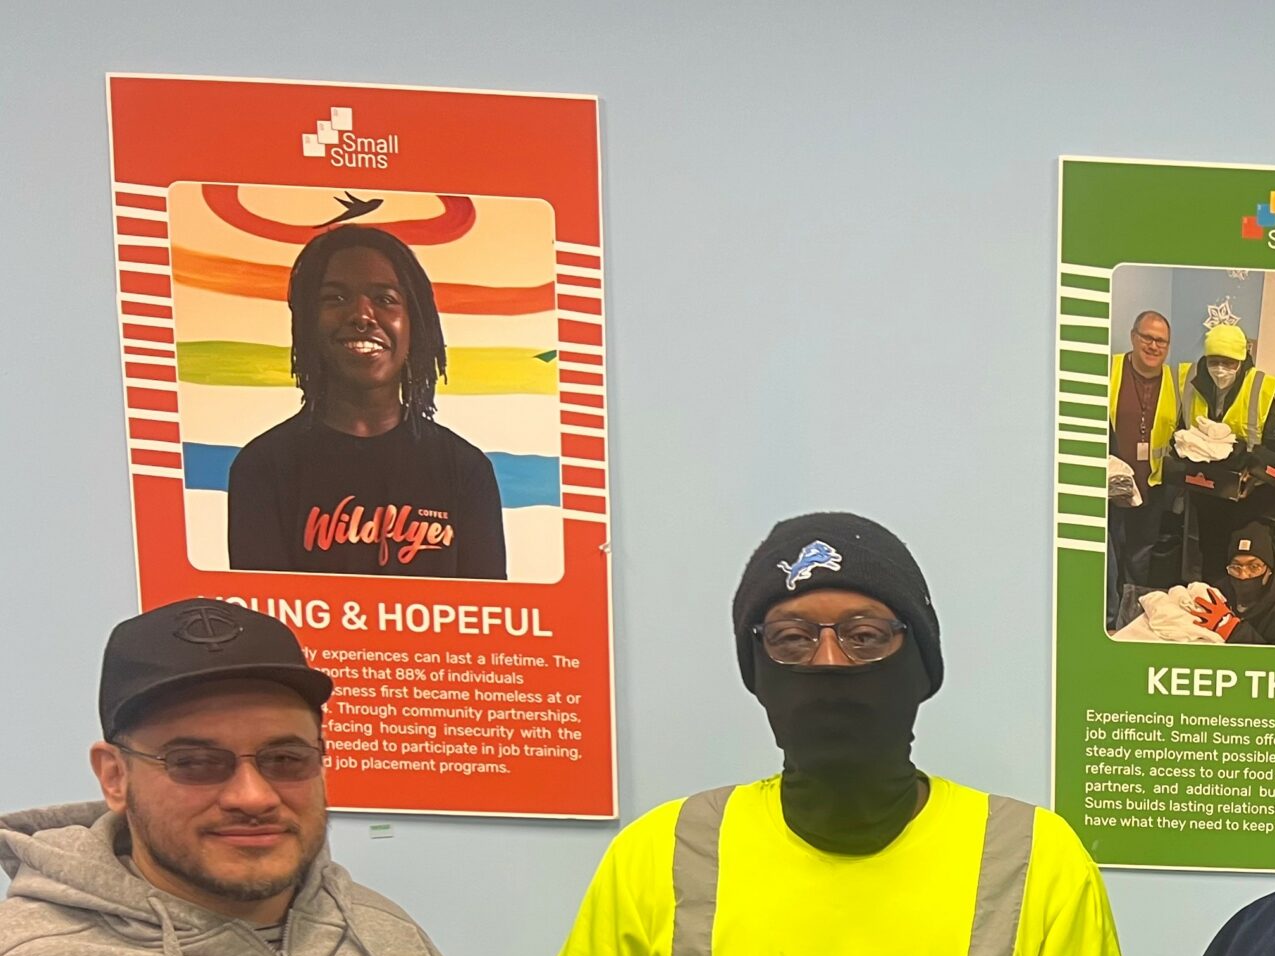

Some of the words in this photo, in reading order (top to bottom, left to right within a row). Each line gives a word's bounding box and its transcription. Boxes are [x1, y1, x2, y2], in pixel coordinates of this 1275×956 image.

[342, 132, 399, 155] Small
[330, 148, 388, 169] Sums
[418, 508, 448, 519] COFFEE
[303, 495, 454, 566] Wildflyer
[341, 601, 368, 631] &
[378, 602, 553, 637] HOPEFUL
[322, 649, 409, 663] experiences
[414, 652, 440, 663] can
[446, 652, 472, 665] last
[477, 655, 486, 665] a
[491, 653, 549, 667] lifetime.
[553, 655, 580, 668] The
[362, 667, 392, 680] that
[395, 668, 426, 681] 88%
[429, 669, 445, 682] of
[448, 670, 524, 684] individuals
[1147, 667, 1238, 697] KEEP
[380, 685, 408, 698] first
[413, 687, 470, 700] became
[474, 689, 543, 703] homeless
[547, 692, 562, 704] at
[566, 694, 581, 704] or
[337, 701, 397, 718] Through
[402, 705, 483, 721] community
[1086, 709, 1174, 727] Experiencing
[1180, 713, 1275, 728] homelessness
[380, 722, 437, 738] housing
[443, 724, 514, 740] insecurity
[520, 727, 551, 739] with
[557, 728, 582, 740] the
[1085, 727, 1106, 742] job
[1111, 728, 1165, 742] difficult.
[1171, 730, 1207, 743] Small
[1212, 732, 1250, 745] Sums
[325, 739, 378, 751] needed
[382, 740, 397, 752] to
[402, 740, 477, 755] participate
[481, 743, 494, 755] in
[498, 743, 520, 758] job
[1085, 745, 1131, 760] steady
[1134, 748, 1218, 762] employment
[335, 755, 357, 770] job
[361, 757, 436, 771] placement
[439, 761, 510, 775] programs.
[1085, 762, 1145, 777] referrals,
[1149, 766, 1196, 777] access
[1200, 766, 1213, 778] to
[1217, 770, 1240, 779] our
[1243, 767, 1273, 780] food
[1085, 780, 1146, 794] partners,
[1153, 783, 1179, 794] and
[1186, 784, 1252, 797] additional
[1085, 797, 1123, 810] Sums
[1126, 798, 1166, 811] builds
[1169, 800, 1214, 816] lasting
[1085, 814, 1117, 826] have
[1120, 816, 1153, 828] what
[1157, 816, 1187, 831] they
[1189, 819, 1222, 830] need
[1225, 819, 1239, 831] to
[1242, 819, 1274, 834] keep
